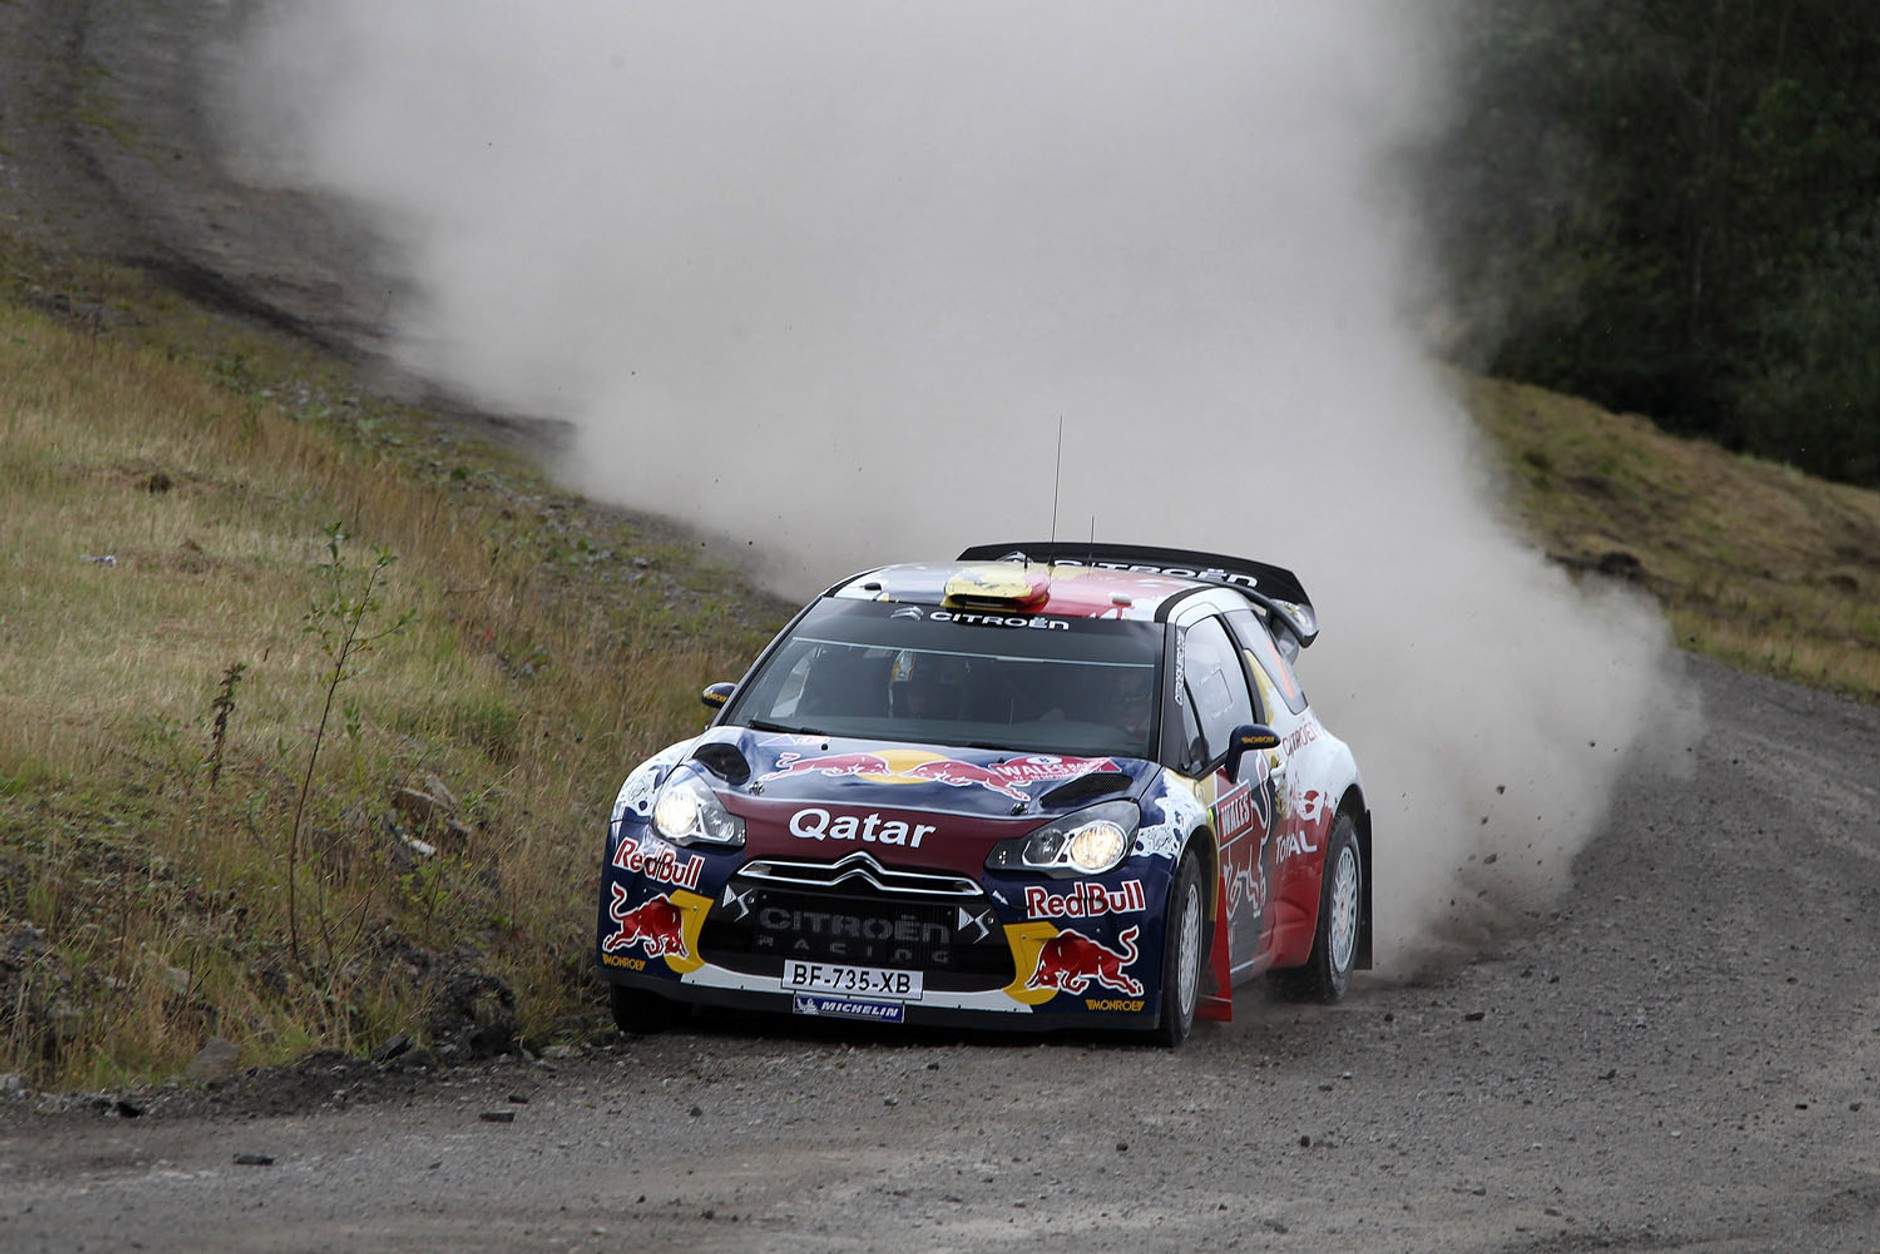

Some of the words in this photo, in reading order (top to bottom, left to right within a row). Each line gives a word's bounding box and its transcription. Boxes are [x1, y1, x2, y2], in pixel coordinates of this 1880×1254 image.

[929, 611, 1070, 631] CITROËN
[1220, 791, 1250, 838] WALES
[789, 808, 936, 849] Qatar
[759, 907, 950, 943] CITROËN
[603, 953, 645, 971] MONROE
[792, 963, 912, 995] BF-735-XB
[820, 1000, 899, 1018] MICHELIN
[1087, 999, 1144, 1012] MONROE
